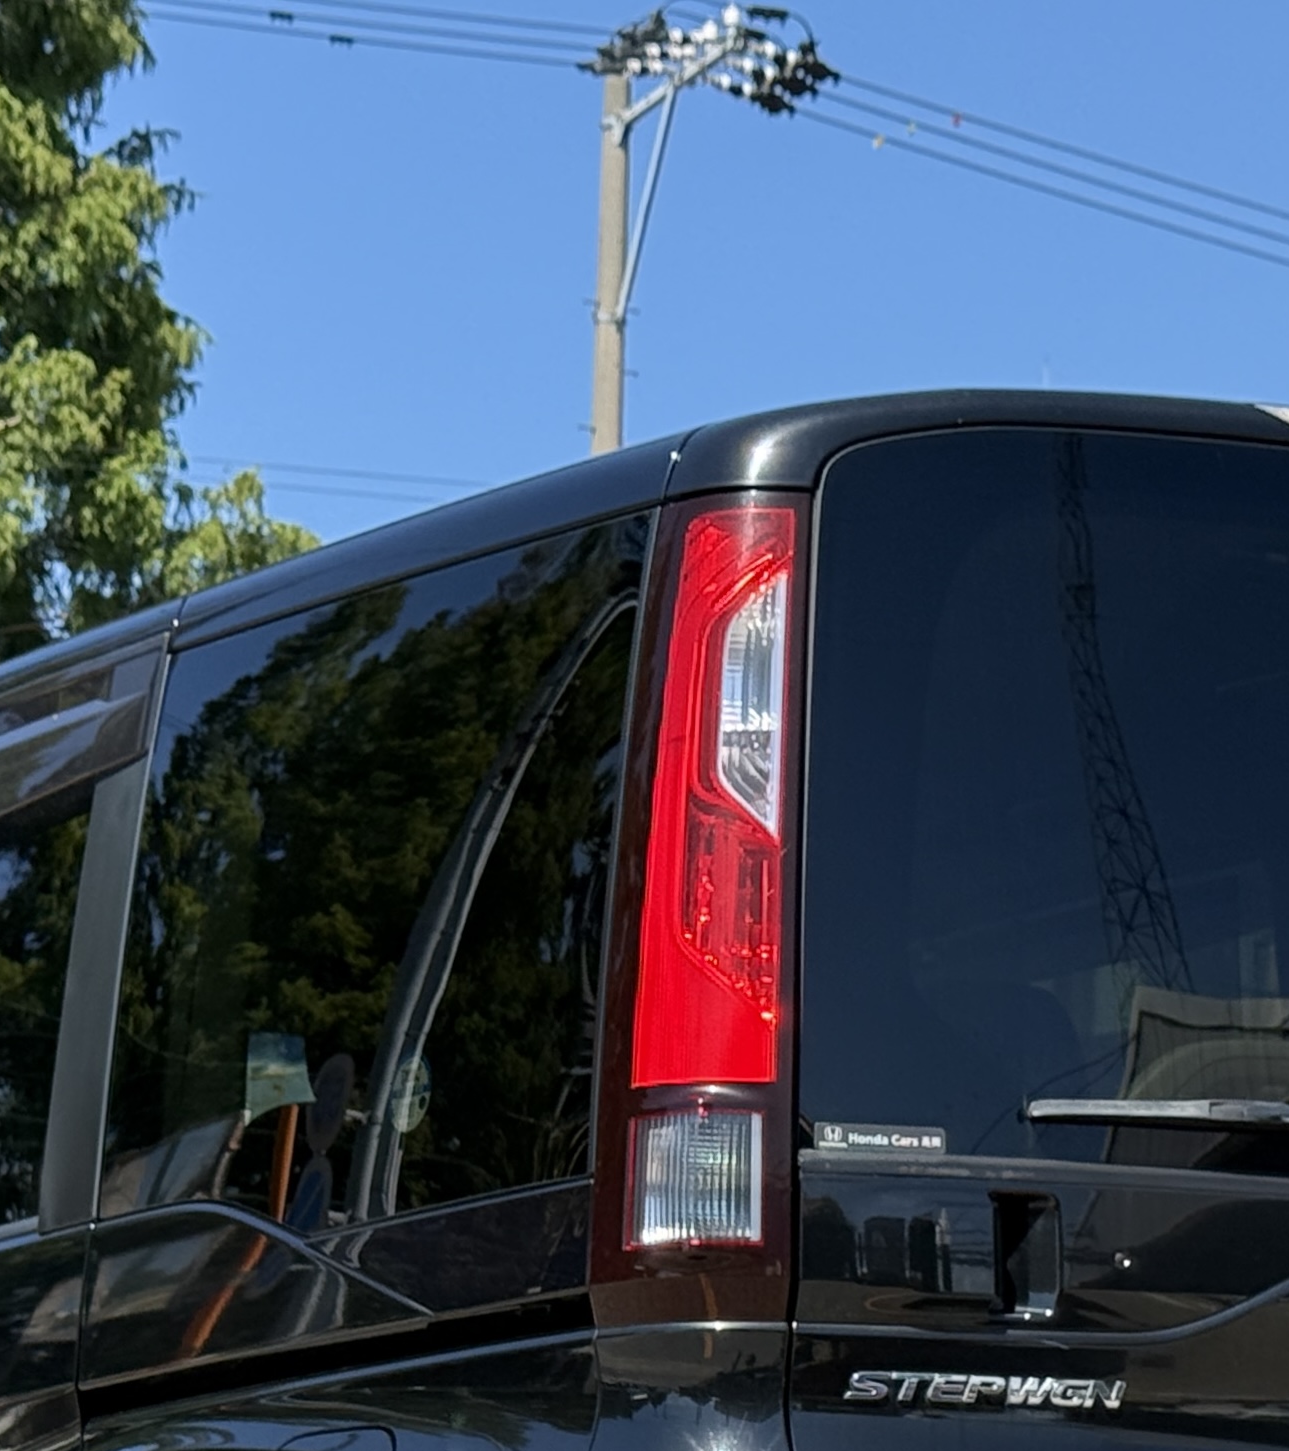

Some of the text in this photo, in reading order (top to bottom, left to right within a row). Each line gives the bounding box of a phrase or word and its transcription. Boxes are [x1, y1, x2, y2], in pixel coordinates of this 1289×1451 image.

[848, 1132, 889, 1146] Honda
[891, 1134, 919, 1148] Cars
[843, 1370, 1127, 1409] STEPWGN
